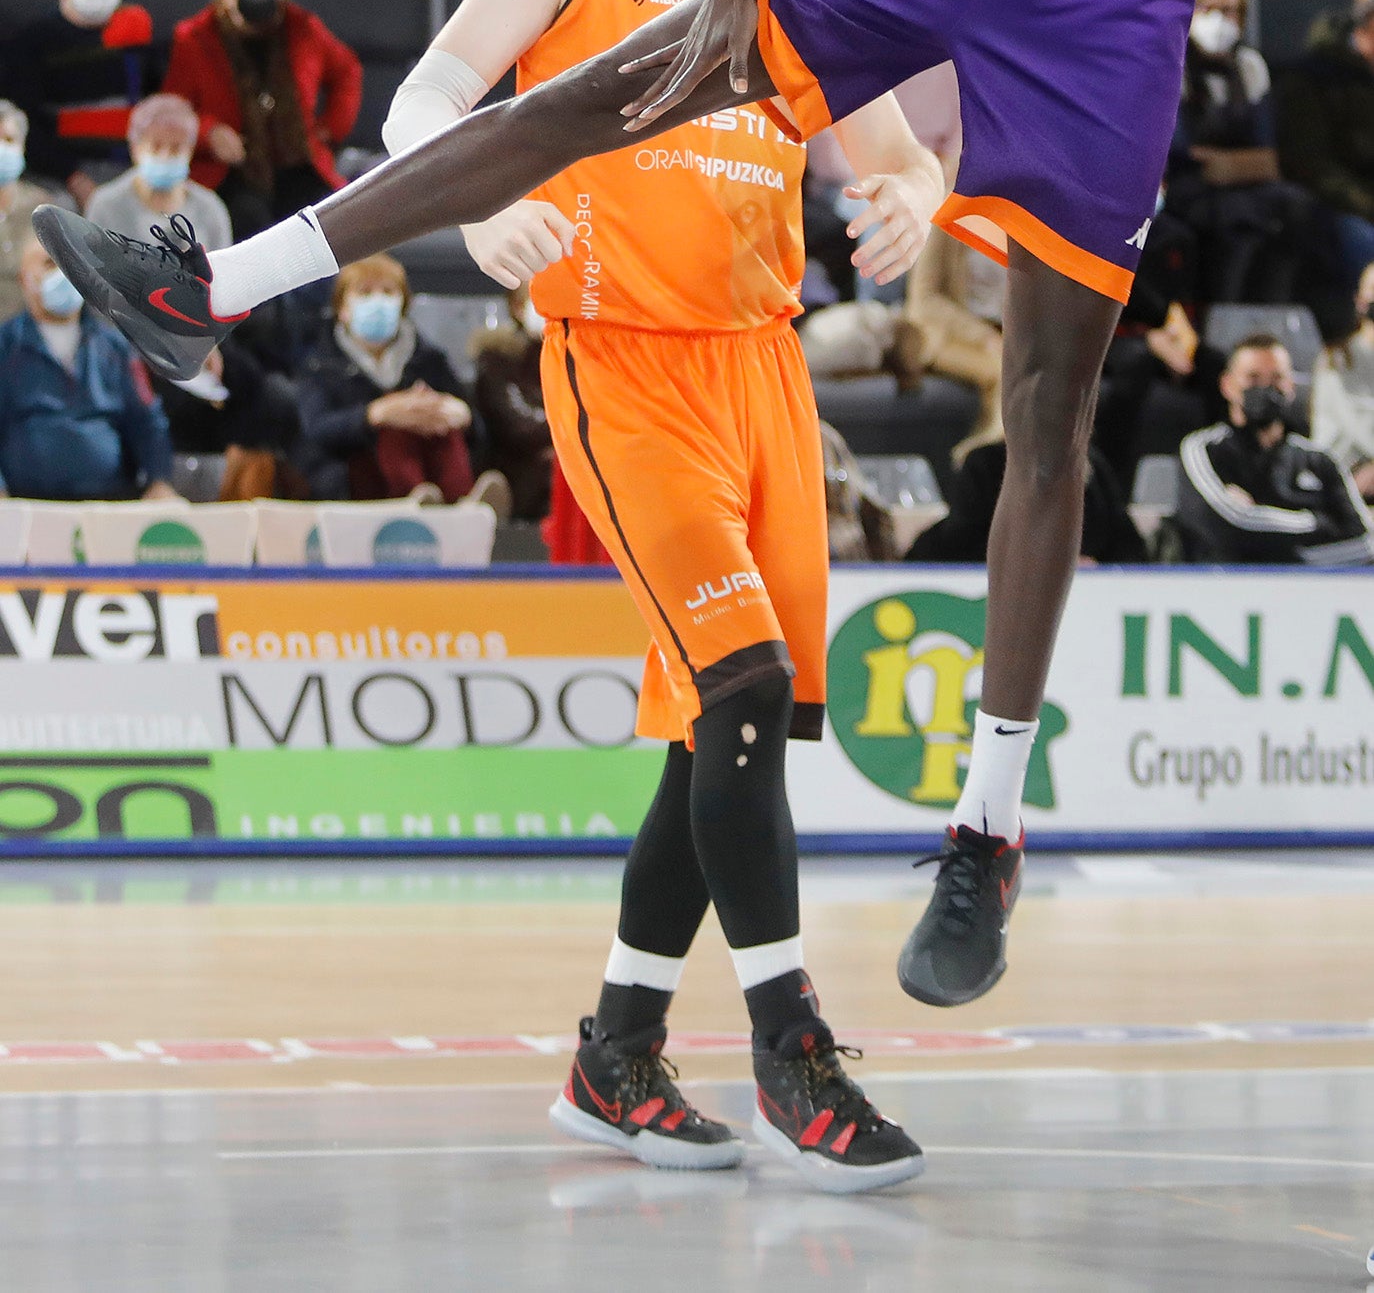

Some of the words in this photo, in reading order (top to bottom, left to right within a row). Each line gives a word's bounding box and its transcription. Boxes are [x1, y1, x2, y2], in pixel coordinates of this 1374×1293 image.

[227, 626, 509, 660] consultores
[1128, 732, 1243, 801] Grupo
[1260, 728, 1374, 785] Indust
